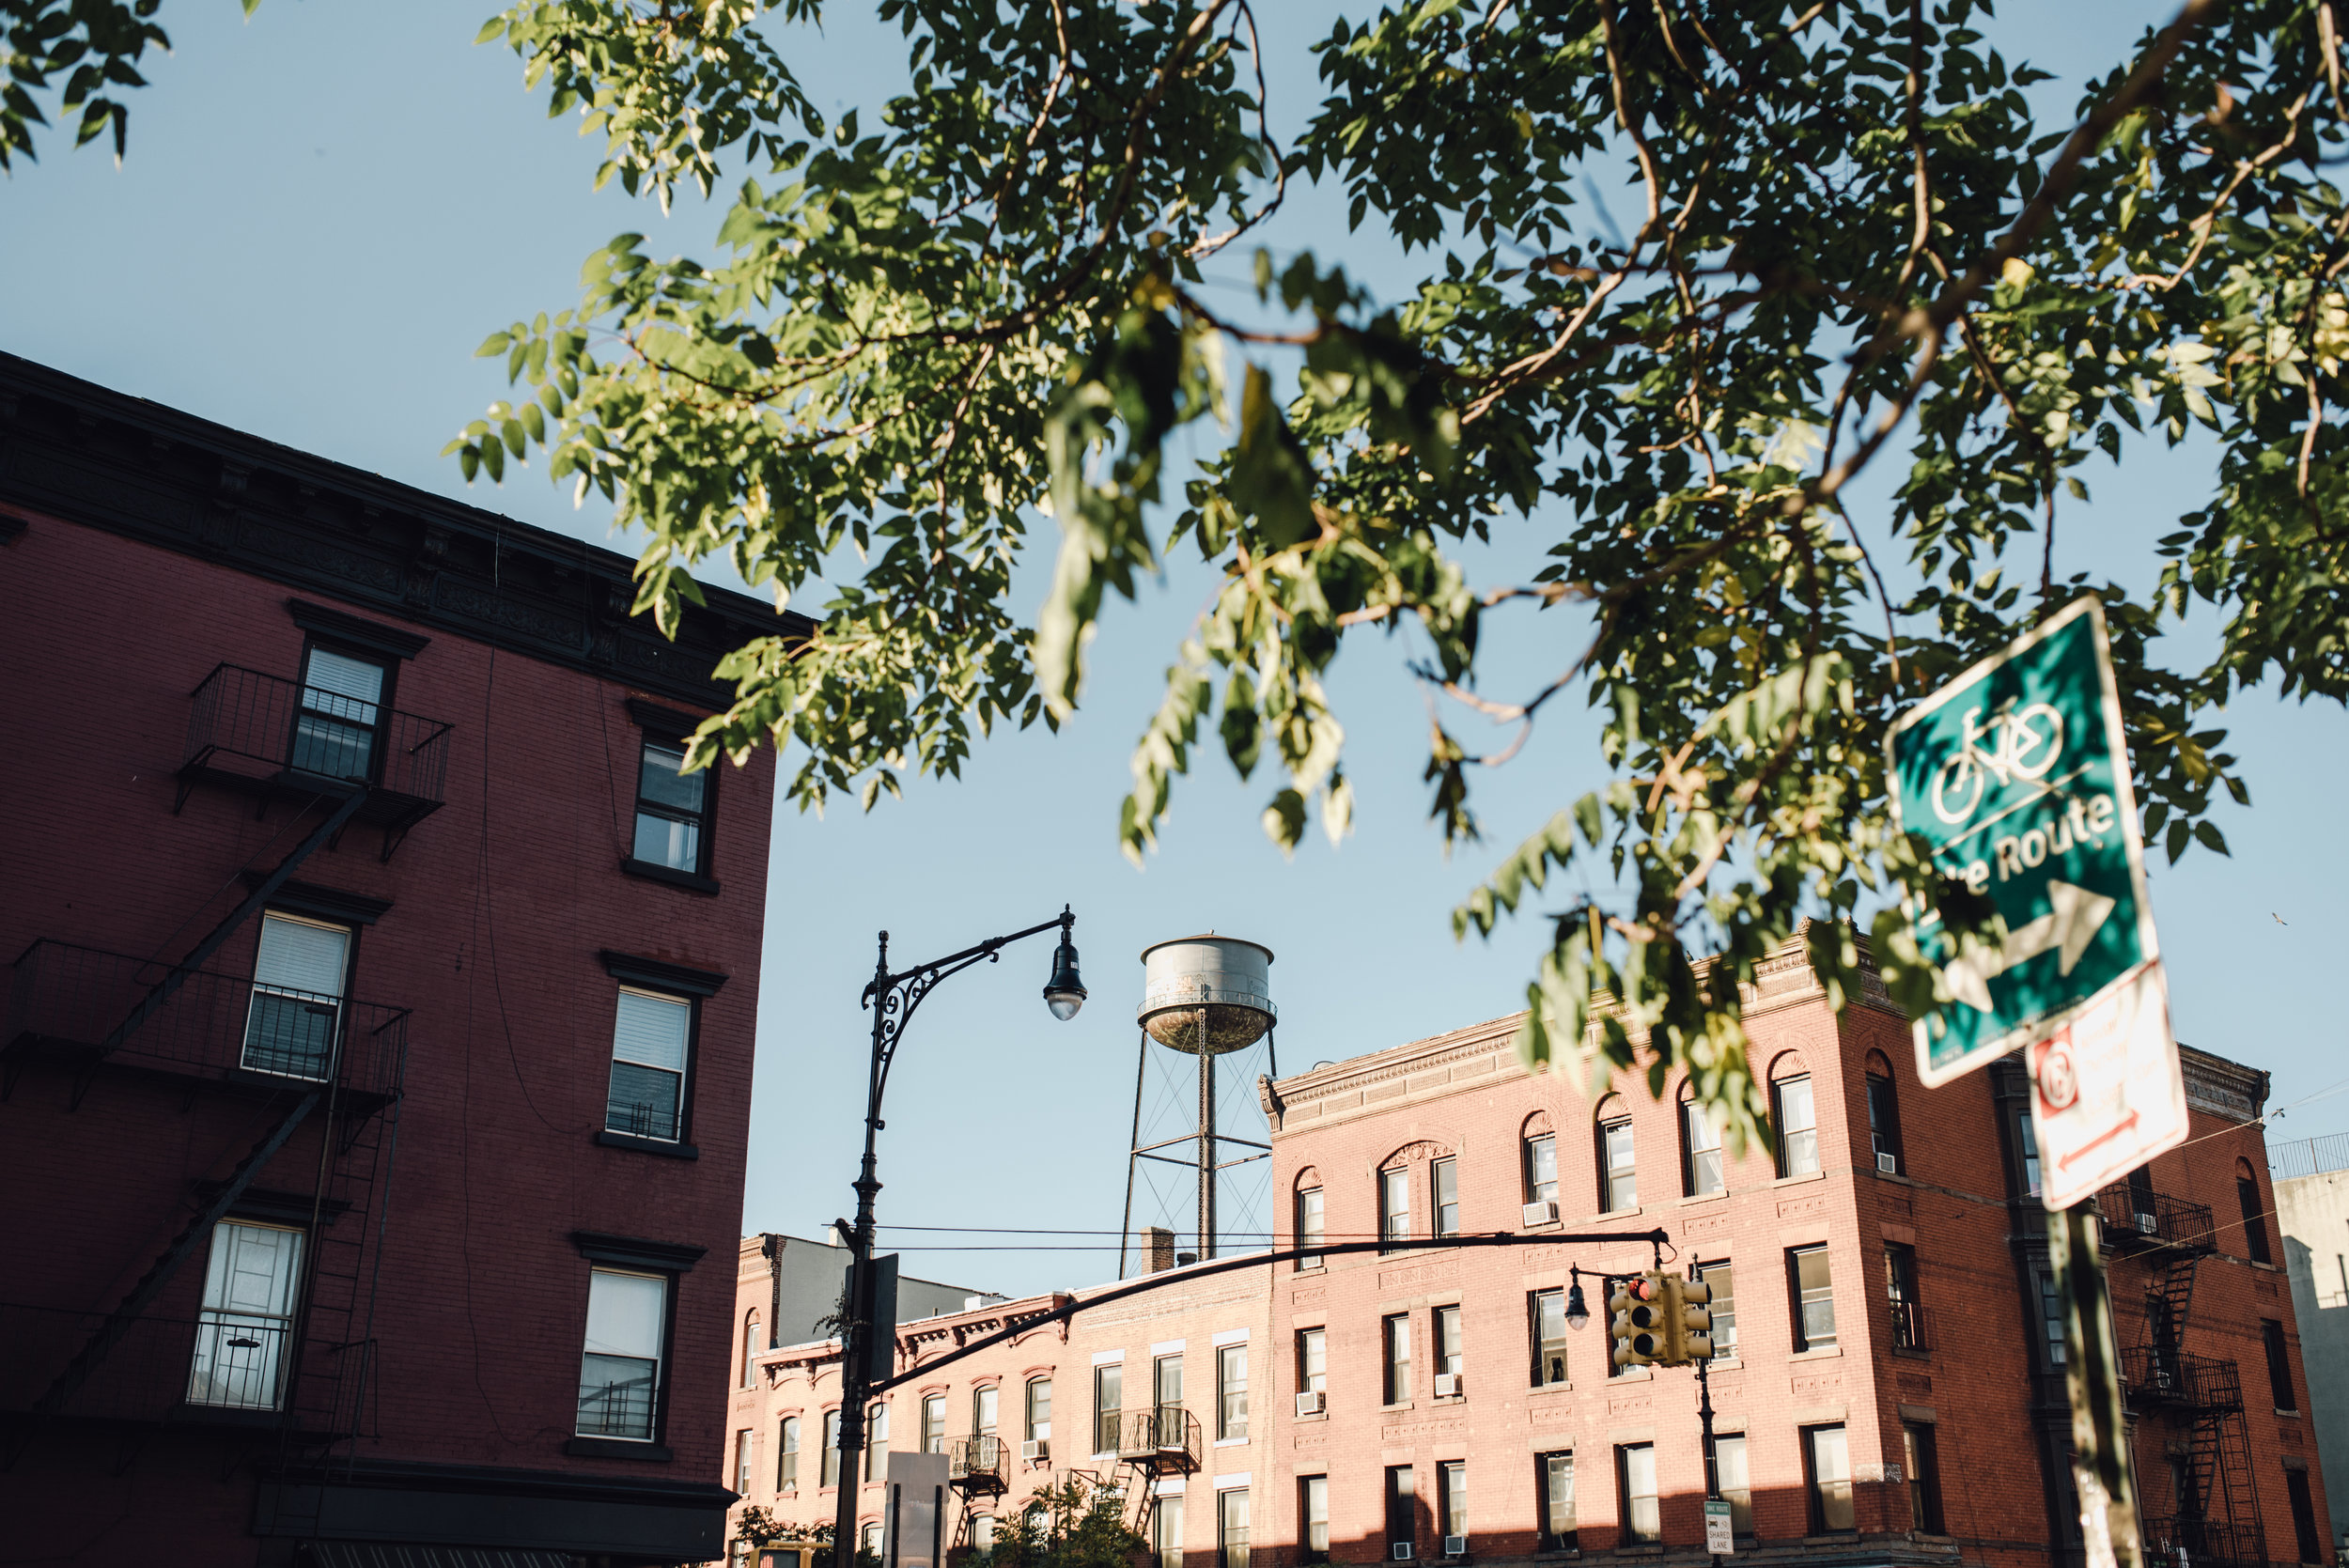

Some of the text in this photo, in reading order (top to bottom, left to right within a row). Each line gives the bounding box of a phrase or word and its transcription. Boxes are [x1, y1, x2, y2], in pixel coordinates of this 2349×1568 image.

[1994, 794, 2114, 882] Route
[1709, 1531, 1730, 1540] SHARED
[1713, 1541, 1727, 1549] LANE
